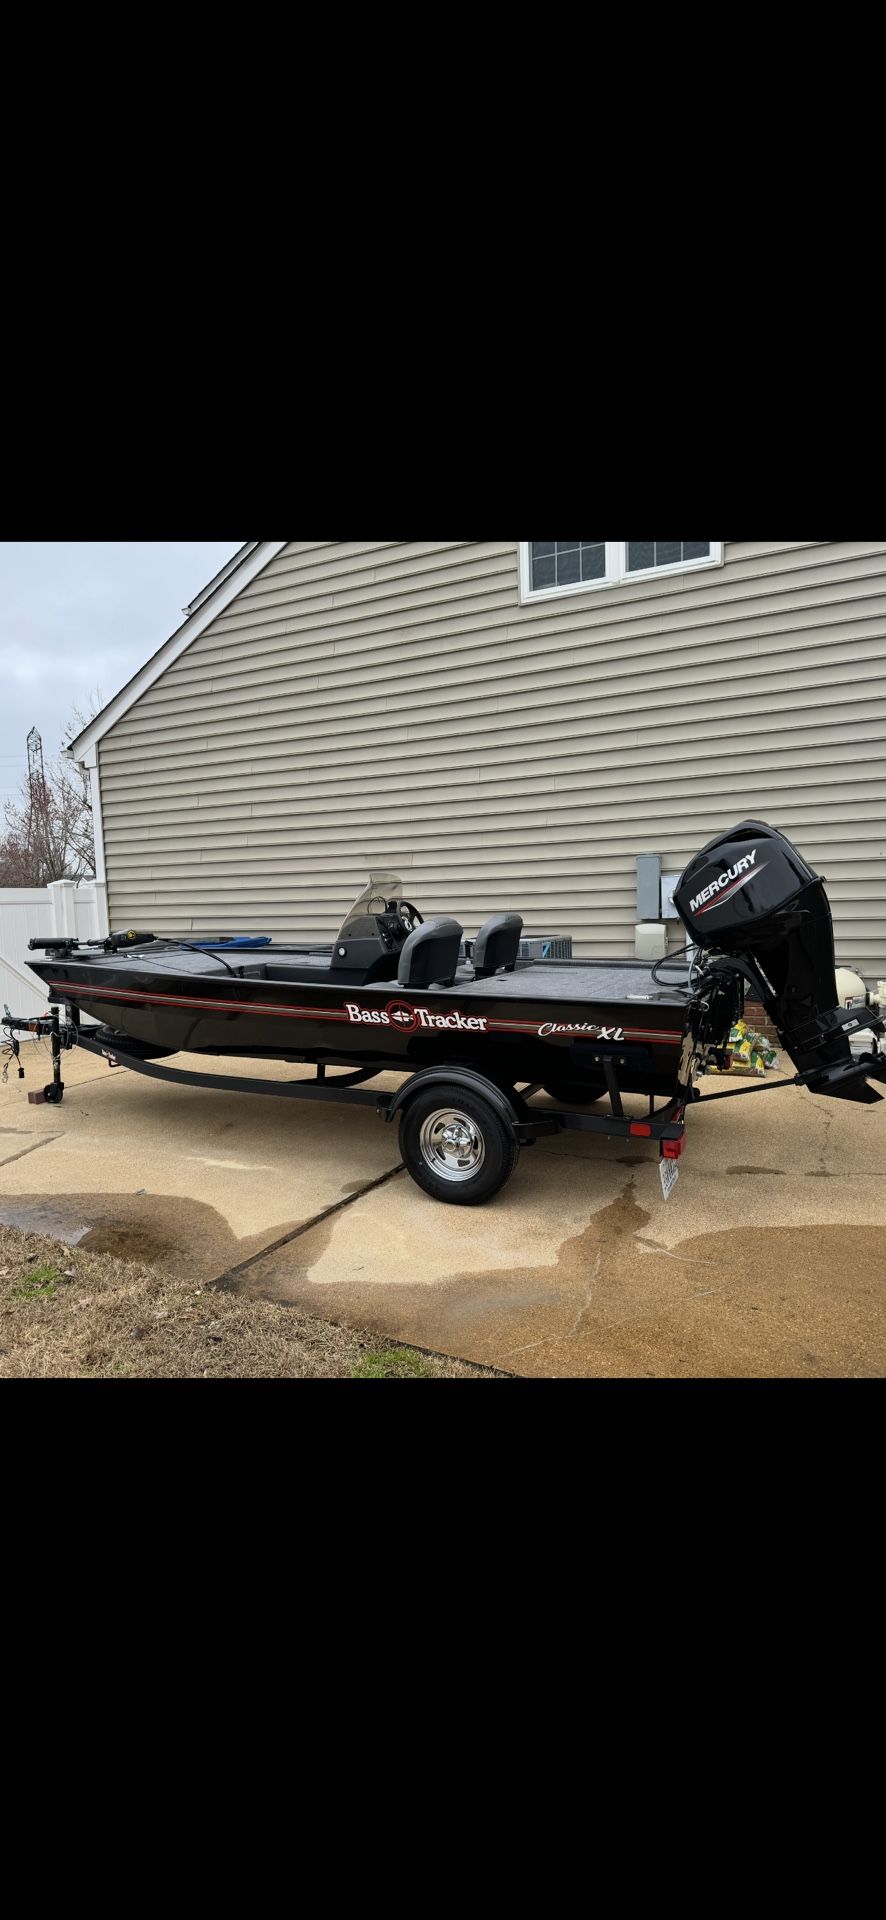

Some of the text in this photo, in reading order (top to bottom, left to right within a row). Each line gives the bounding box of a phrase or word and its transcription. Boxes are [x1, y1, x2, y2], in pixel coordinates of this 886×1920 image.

[689, 849, 757, 912] MERCURY
[346, 1004, 487, 1031] Bass Tracker
[537, 1022, 625, 1041] Classic XL
